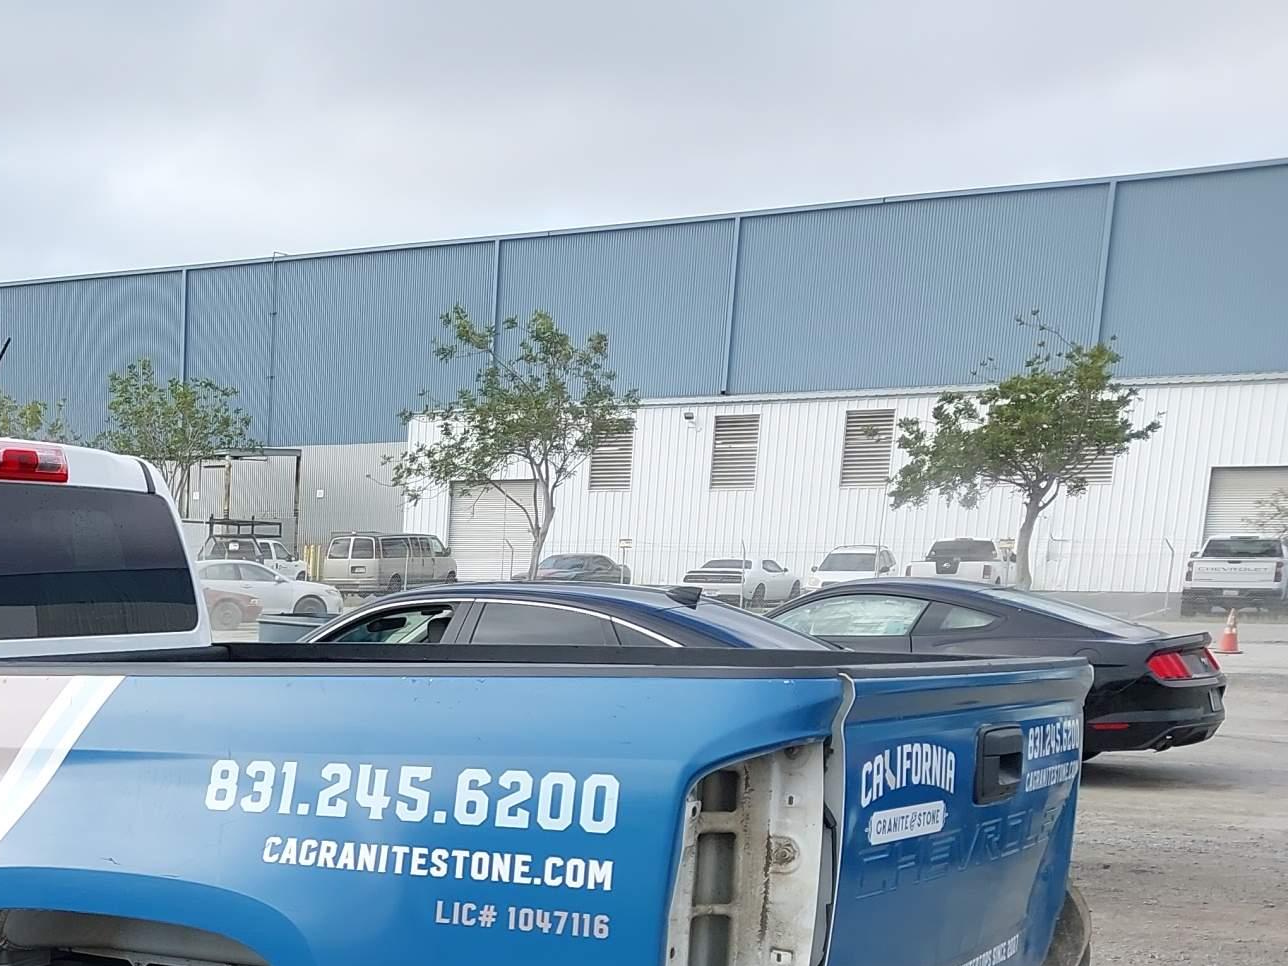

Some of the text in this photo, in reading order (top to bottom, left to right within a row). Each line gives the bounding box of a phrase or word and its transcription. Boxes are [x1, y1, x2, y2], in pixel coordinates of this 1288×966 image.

[1027, 718, 1080, 760] 831.245.6200
[204, 759, 620, 834] 831.245.6200
[860, 743, 956, 808] CALIFORNIA
[875, 815, 910, 836] GRANITE
[918, 809, 941, 828] STONE
[262, 836, 614, 891] CAGRANITESTONE.COM
[435, 900, 610, 939] LIC# 1047116
